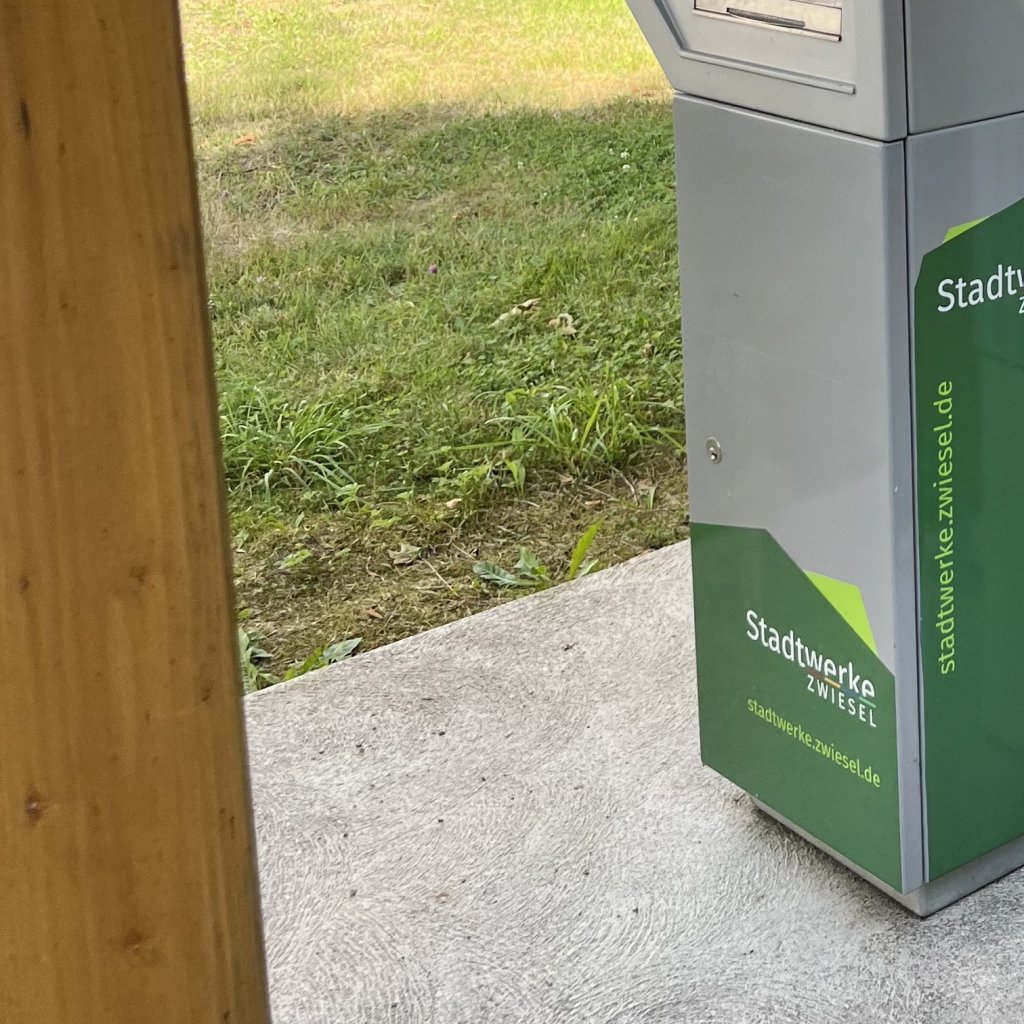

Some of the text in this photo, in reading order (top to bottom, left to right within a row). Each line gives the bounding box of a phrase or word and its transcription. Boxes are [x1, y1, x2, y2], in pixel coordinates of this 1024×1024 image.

[933, 380, 955, 676] stadtwerke.zwiesel.de
[746, 609, 876, 698] Stadtwerke
[747, 697, 881, 788] stadtwerke.zwiesel.de
[807, 674, 877, 728] ZWIESEL
